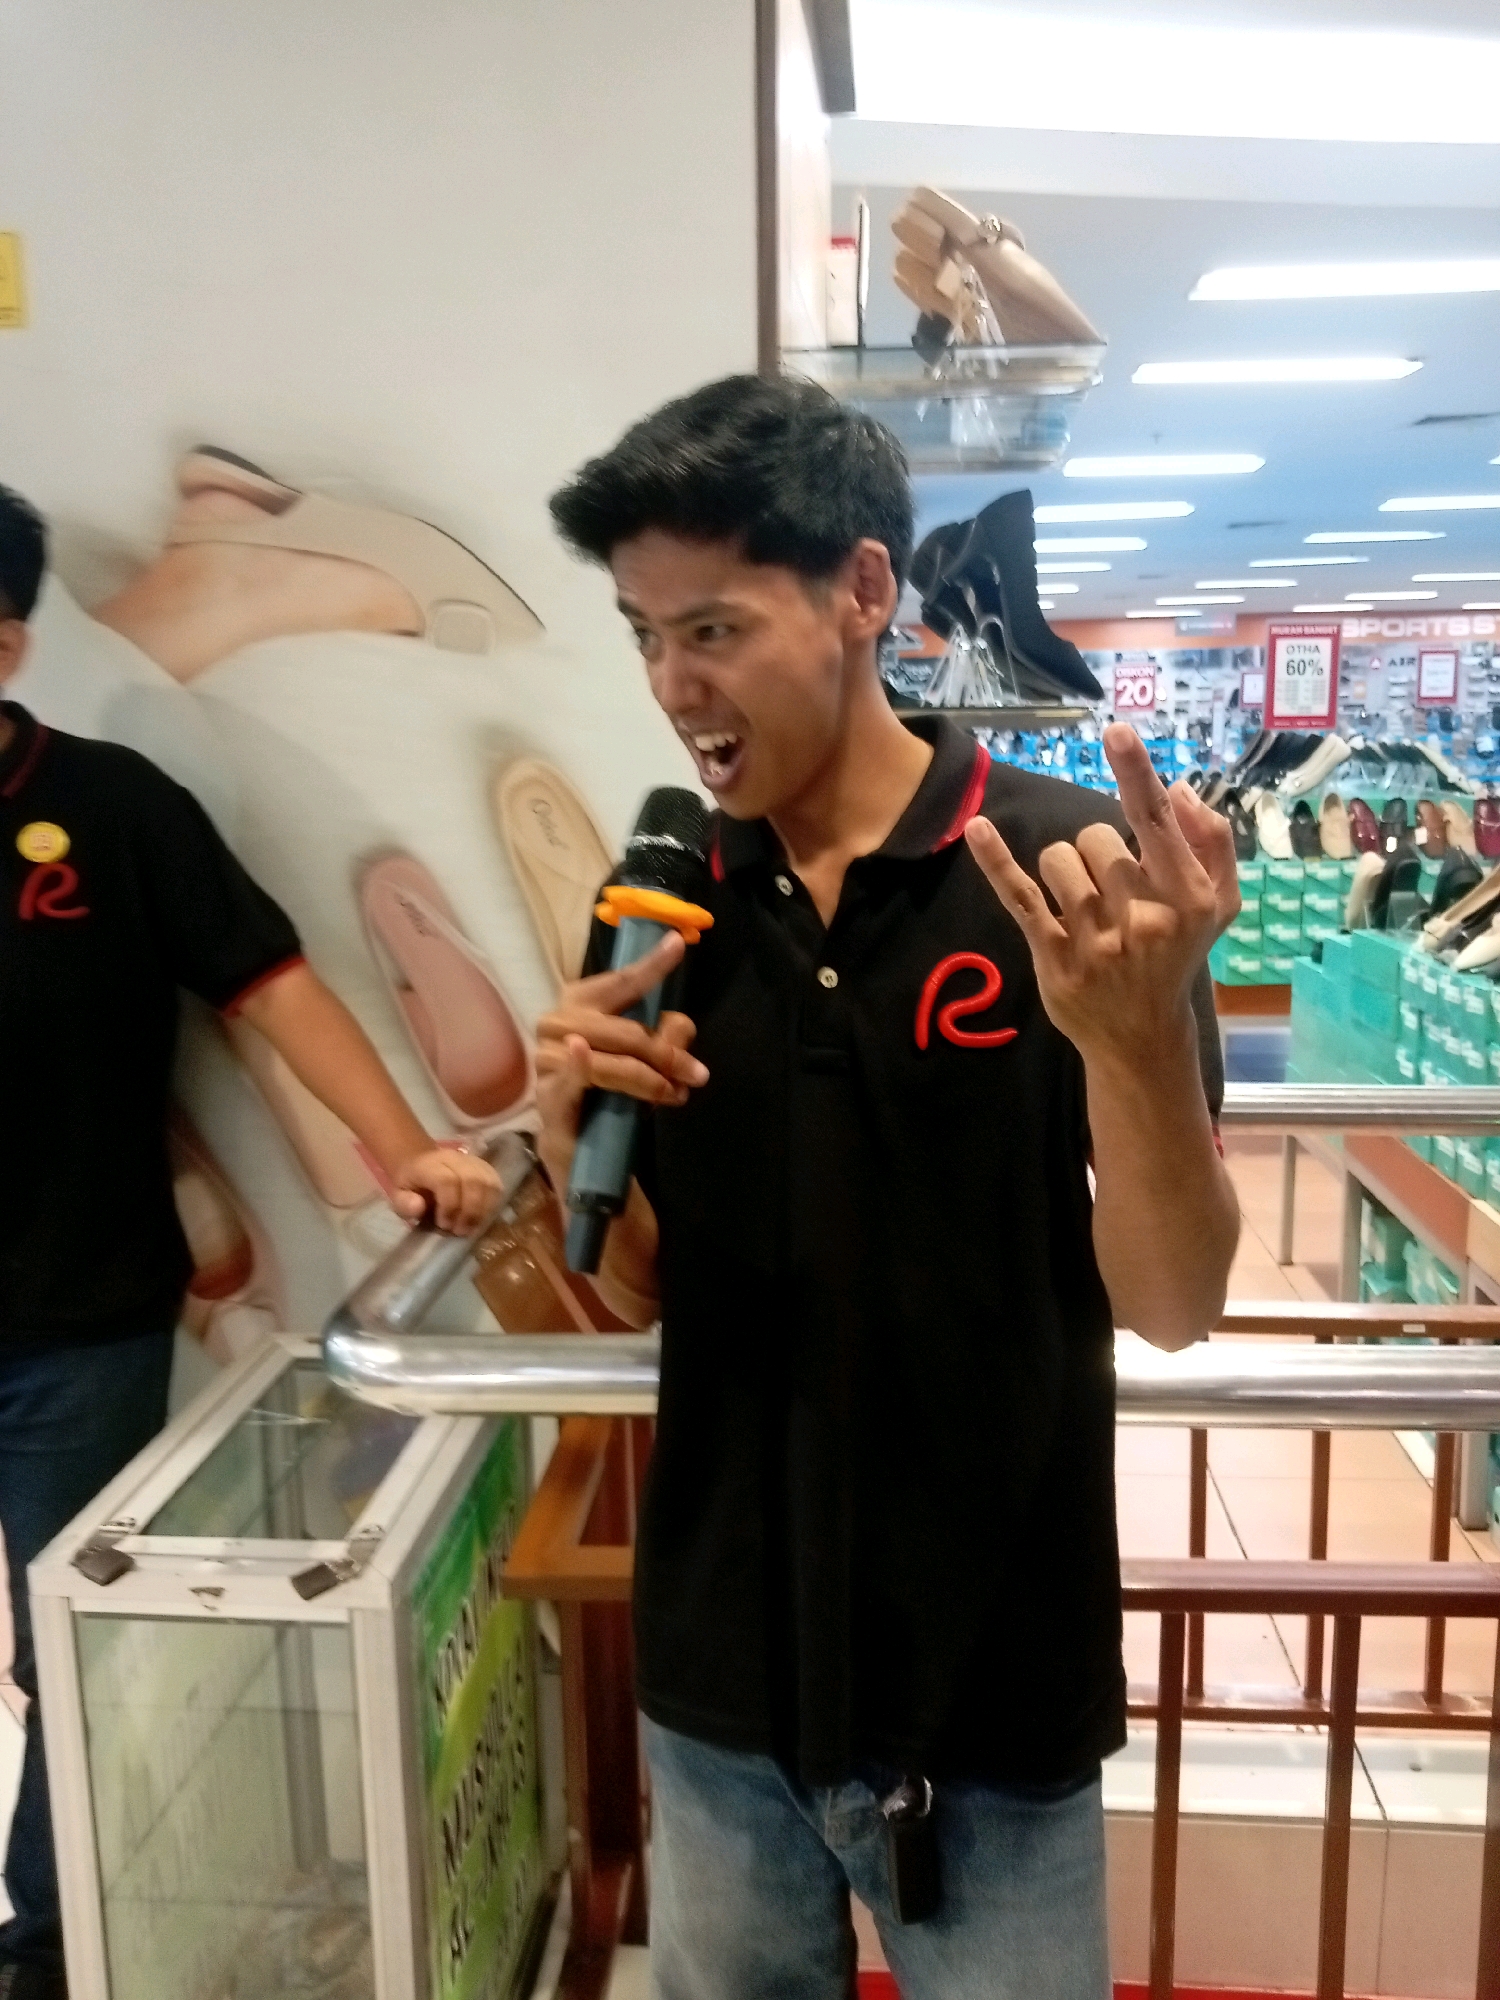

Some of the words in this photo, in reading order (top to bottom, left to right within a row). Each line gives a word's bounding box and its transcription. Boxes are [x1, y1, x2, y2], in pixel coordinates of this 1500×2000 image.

[1286, 659, 1324, 676] 60%
[1115, 678, 1154, 707] 20
[19, 862, 90, 920] R
[915, 951, 1018, 1050] R
